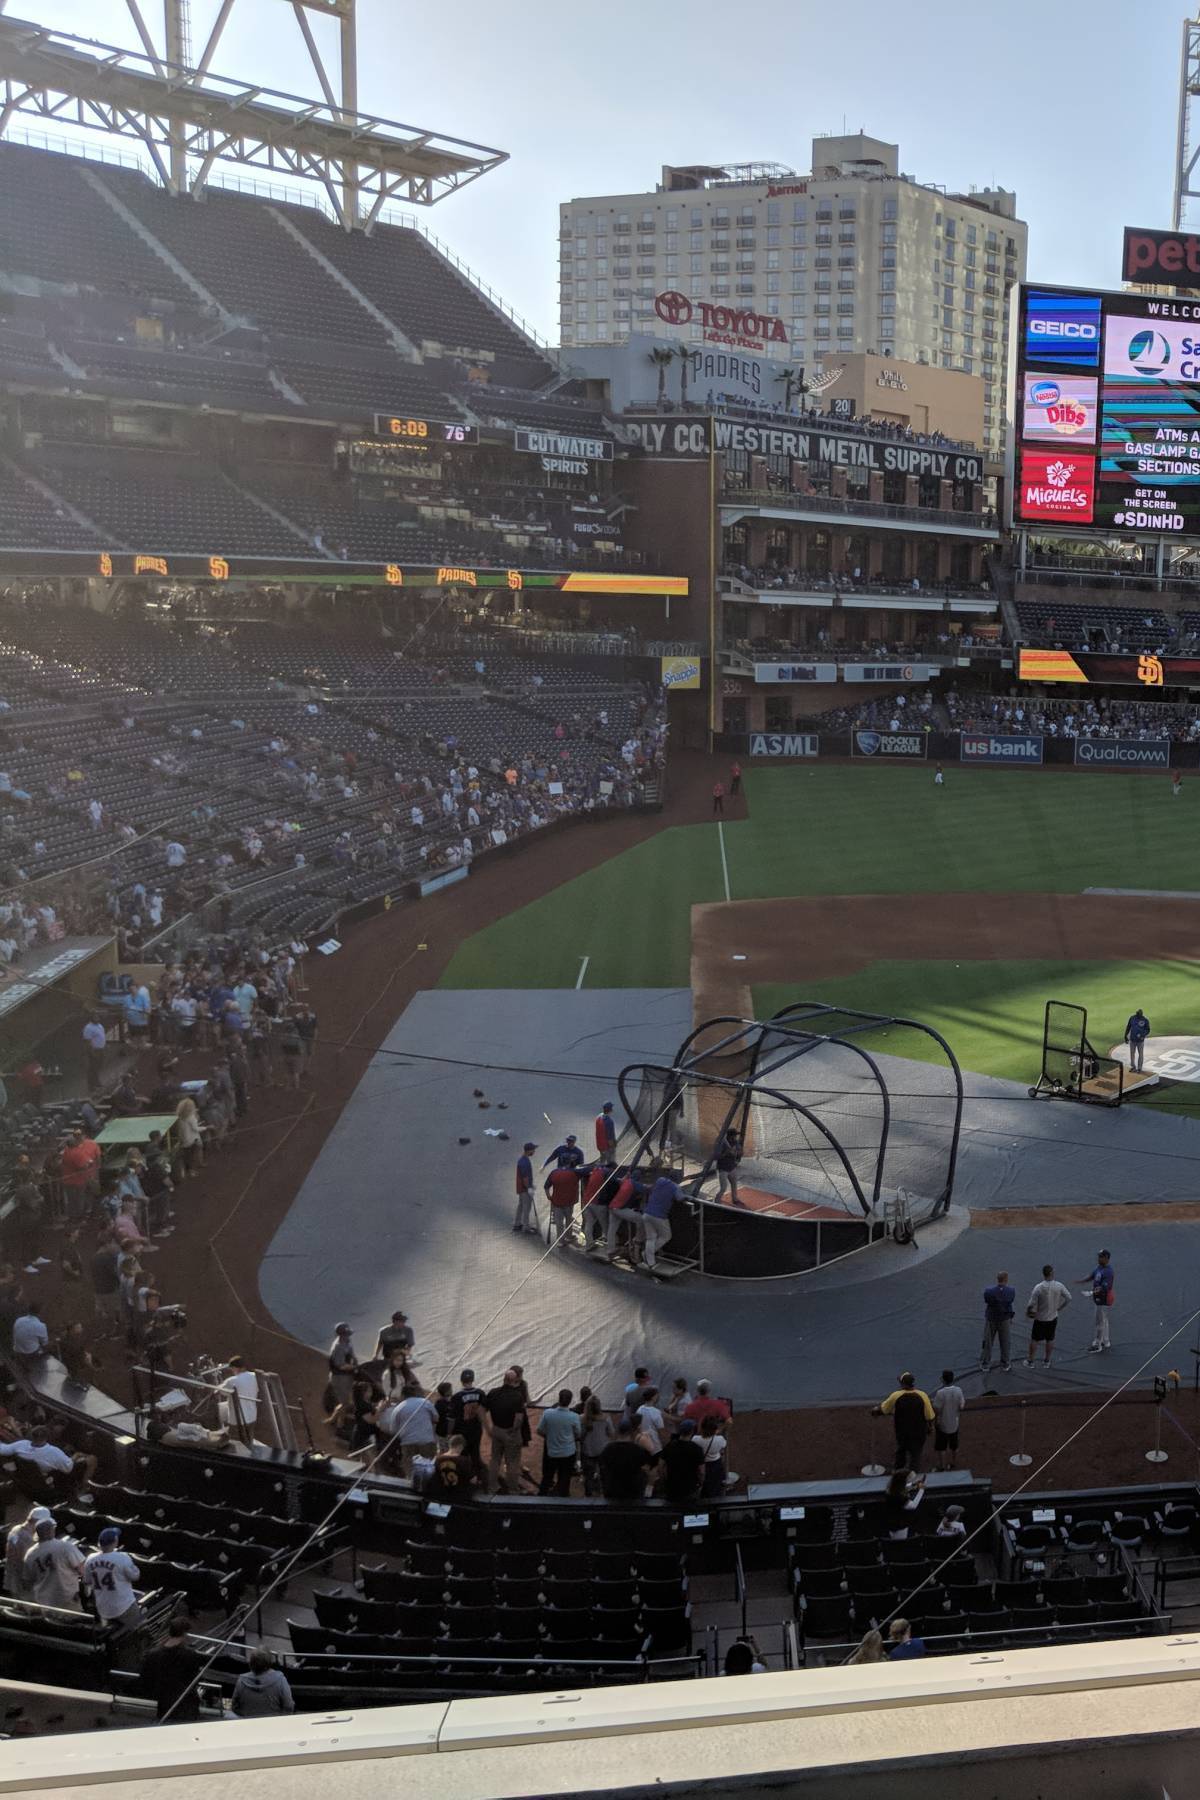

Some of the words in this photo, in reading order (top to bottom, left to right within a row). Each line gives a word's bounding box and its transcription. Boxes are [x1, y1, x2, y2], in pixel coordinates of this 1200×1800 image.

[697, 302, 789, 343] TOYOTA
[1030, 319, 1097, 339] GEICO
[693, 351, 760, 395] PADRES
[834, 399, 849, 413] 20
[1046, 403, 1086, 428] Dibs
[390, 418, 428, 438] 6:09
[1155, 428, 1189, 442] ATMs
[528, 432, 604, 458] CUTWATER
[674, 423, 711, 454] CO.
[714, 421, 810, 459] WESTERN
[819, 437, 880, 468] METAL
[884, 446, 949, 477] SUPPLY
[955, 457, 982, 481] CO.
[1125, 442, 1186, 458] GASLAMP
[542, 457, 589, 476] SPIRITS
[1138, 459, 1200, 475] SECTIONS
[1135, 488, 1153, 498] GET
[1154, 490, 1167, 499] ON
[1124, 498, 1142, 508] THE
[1142, 500, 1177, 510] SCREEN
[134, 554, 169, 575] PADRES
[436, 567, 477, 587] PADRES
[752, 735, 817, 756] ASML
[881, 736, 921, 746] ROCKET
[881, 744, 921, 754] LEAGUE
[1079, 743, 1166, 761] Qualcomm
[91, 1571, 116, 1591] 14
